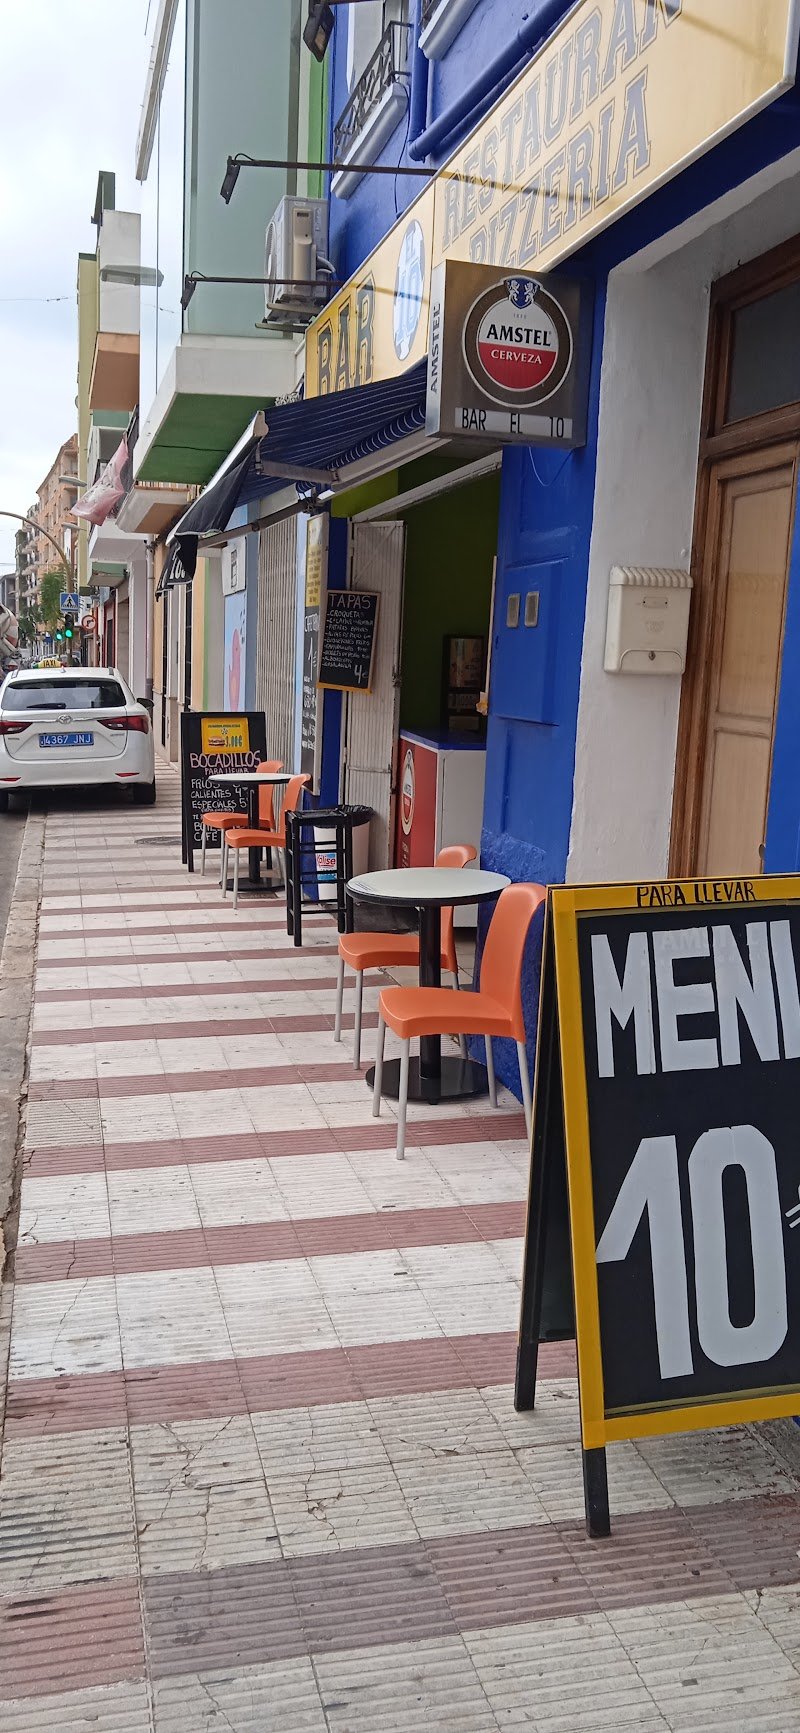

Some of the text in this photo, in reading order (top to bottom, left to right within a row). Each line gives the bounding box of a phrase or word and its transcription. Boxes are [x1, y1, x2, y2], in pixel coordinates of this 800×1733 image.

[317, 270, 376, 397] BAR
[486, 324, 551, 347] AMSTEL
[430, 303, 441, 393] AMSTEL
[490, 349, 542, 364] CERVEZA
[462, 407, 564, 438] BAR EL 10
[329, 593, 371, 610] TAPAS
[329, 609, 363, 618] CROQUETA
[43, 659, 56, 667] TAXI
[45, 733, 91, 745] 4367 JNJ
[190, 750, 261, 768] BOCADILLOS
[205, 767, 223, 775] PARA
[637, 881, 756, 908] PARA LLEVAR
[596, 1123, 789, 1380] 10
